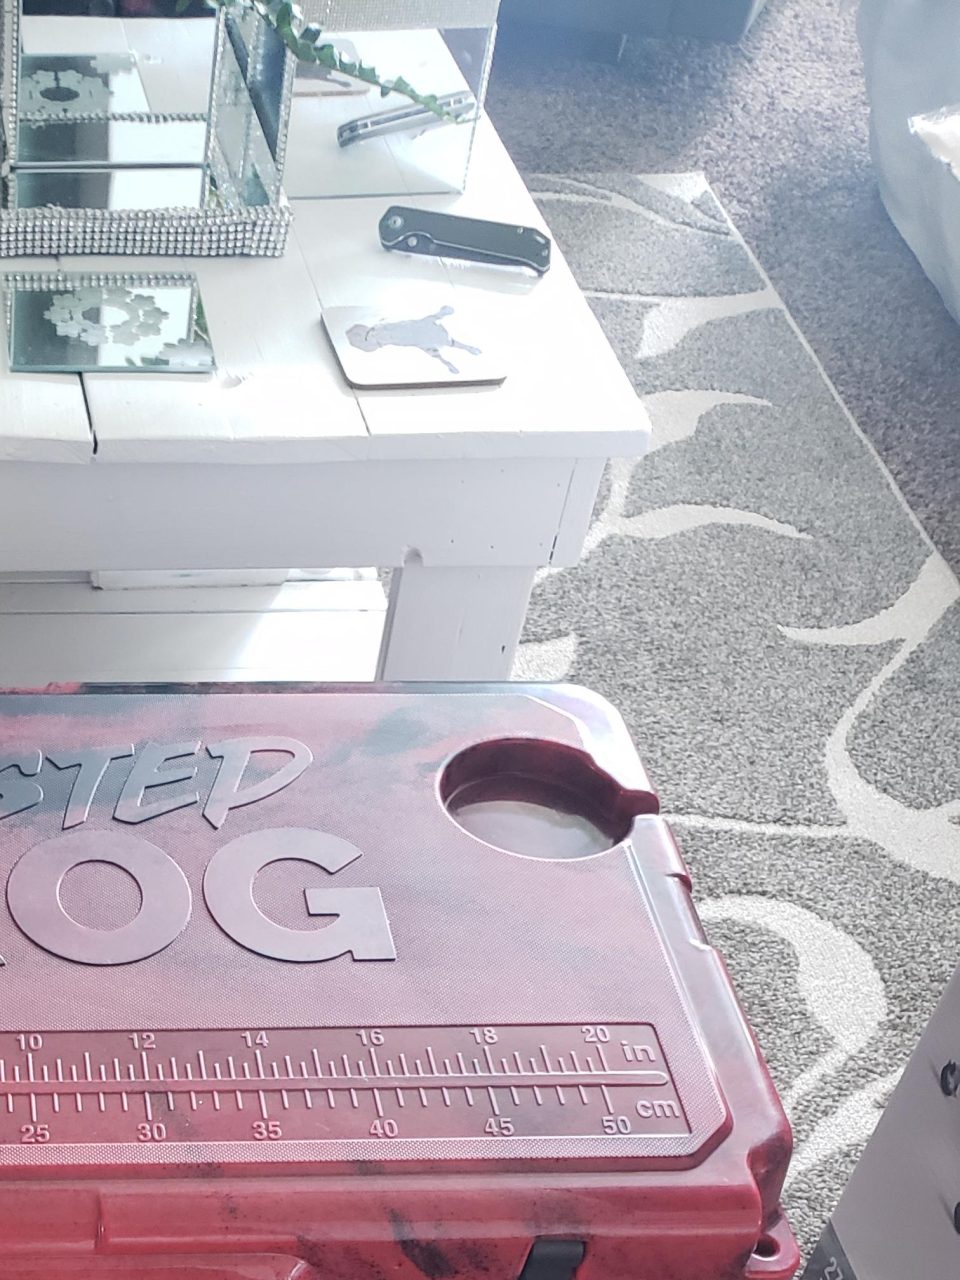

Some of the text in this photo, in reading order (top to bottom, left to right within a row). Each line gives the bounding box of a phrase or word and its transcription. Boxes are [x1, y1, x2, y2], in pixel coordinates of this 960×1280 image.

[17, 1034, 43, 1050] 10
[128, 1032, 156, 1049] 12
[241, 1031, 269, 1047] 14
[356, 1029, 384, 1046] 16
[469, 1028, 498, 1044] 18
[582, 1026, 610, 1043] 20
[620, 1041, 655, 1062] in
[21, 1125, 50, 1143] 25
[137, 1124, 166, 1141] 30
[252, 1122, 281, 1140] 35
[369, 1120, 398, 1138] 40
[484, 1118, 514, 1136] 45
[602, 1116, 631, 1134] 50
[635, 1099, 679, 1118] cm
